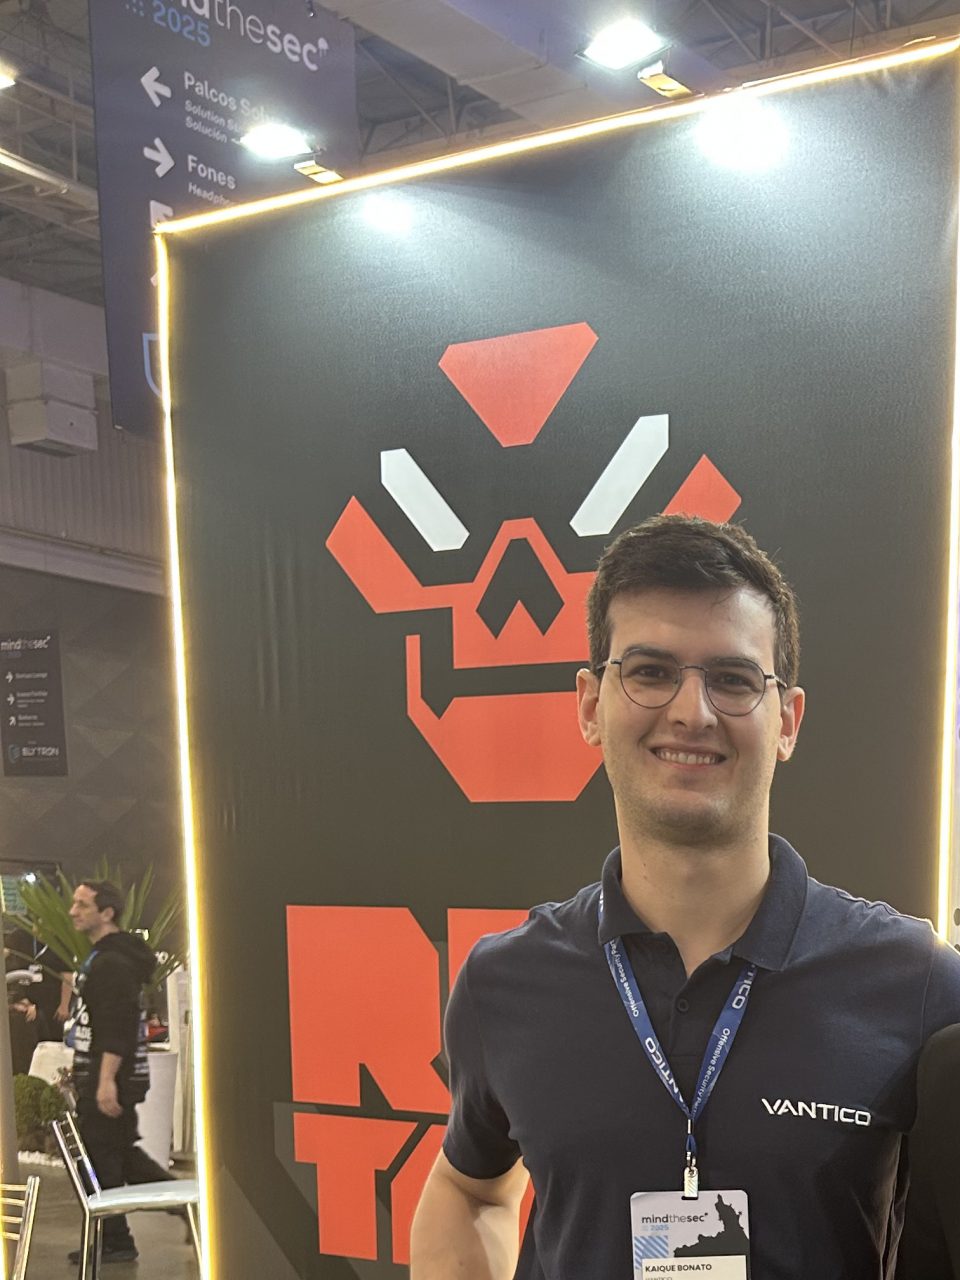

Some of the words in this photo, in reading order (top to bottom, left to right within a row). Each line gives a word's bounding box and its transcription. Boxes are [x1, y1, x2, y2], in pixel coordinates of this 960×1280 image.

[152, 0, 211, 47] 2025
[184, 71, 237, 111] Palcos
[184, 100, 226, 127] Solution
[185, 116, 228, 143] Solución
[187, 154, 236, 190] Fones
[188, 182, 234, 204] Headph
[710, 1028, 731, 1068] Offensive
[761, 1098, 872, 1126] VANTICO
[641, 1213, 705, 1224] mindthesec
[645, 1265, 676, 1273] KAIQUE
[677, 1264, 713, 1272] BONATO
